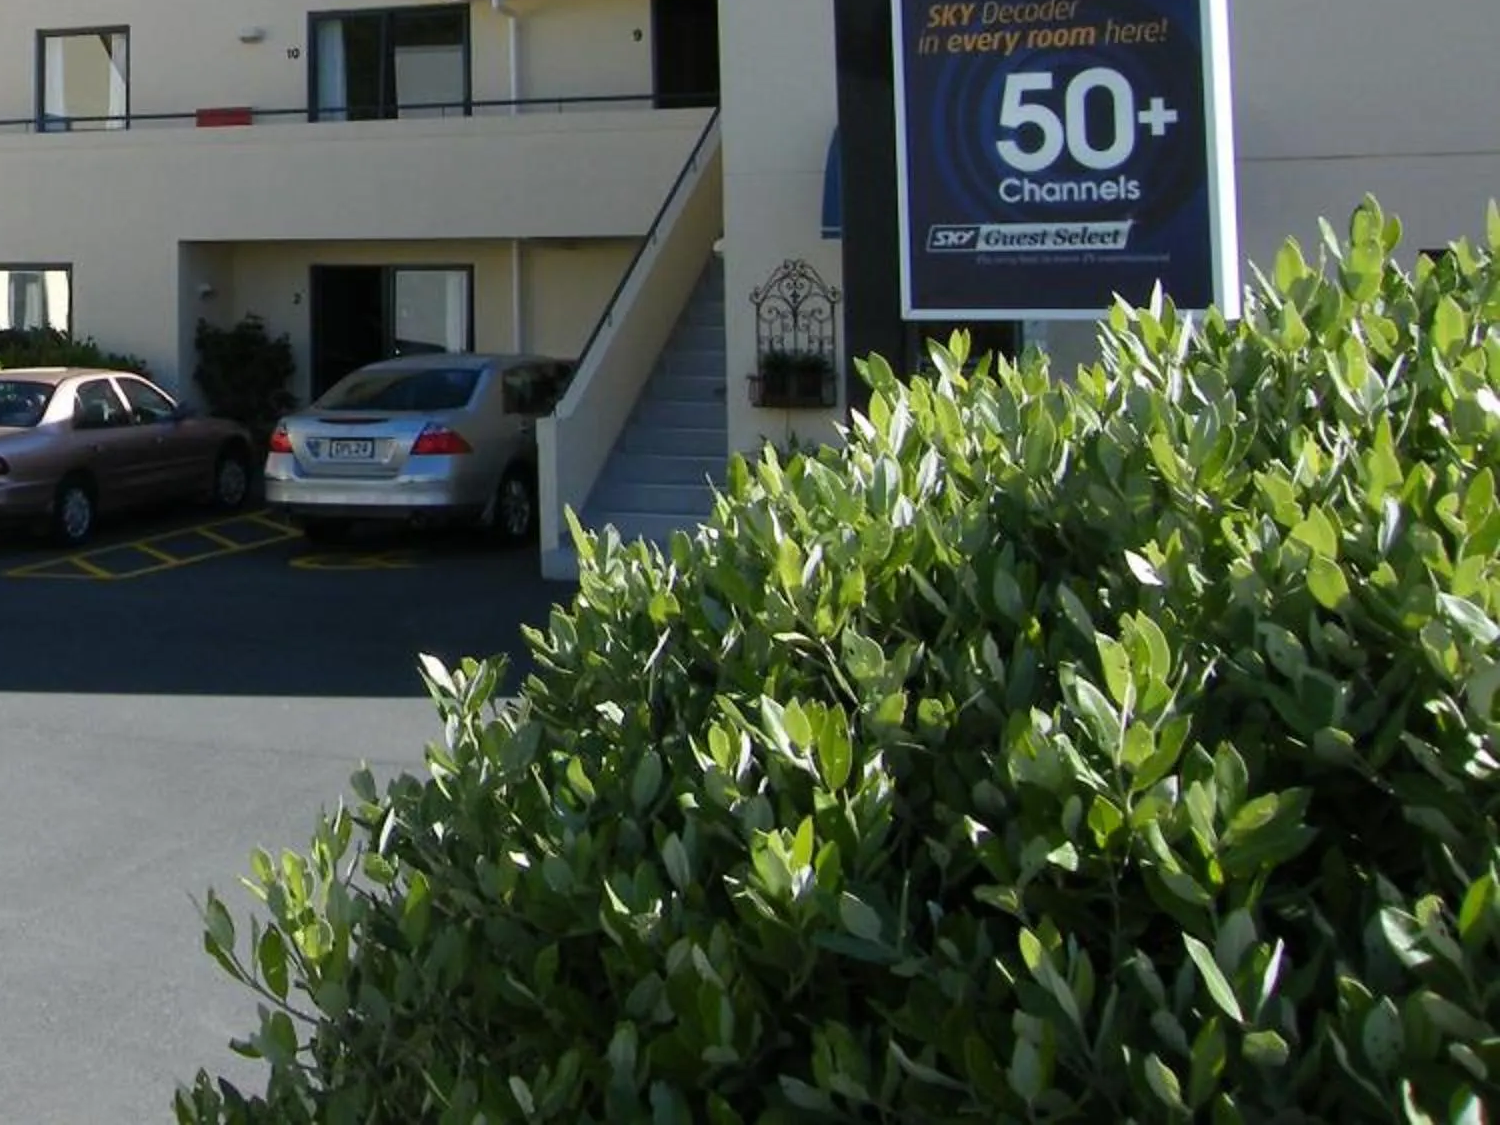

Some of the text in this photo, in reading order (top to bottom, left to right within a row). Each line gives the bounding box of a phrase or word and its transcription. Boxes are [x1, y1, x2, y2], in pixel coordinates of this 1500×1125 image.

[928, 2, 975, 28] SKY
[918, 18, 1169, 56] in every room here!
[996, 67, 1178, 172] 50+
[999, 175, 1141, 203] Channels
[984, 226, 1047, 246] Guest
[1052, 225, 1120, 246] Select
